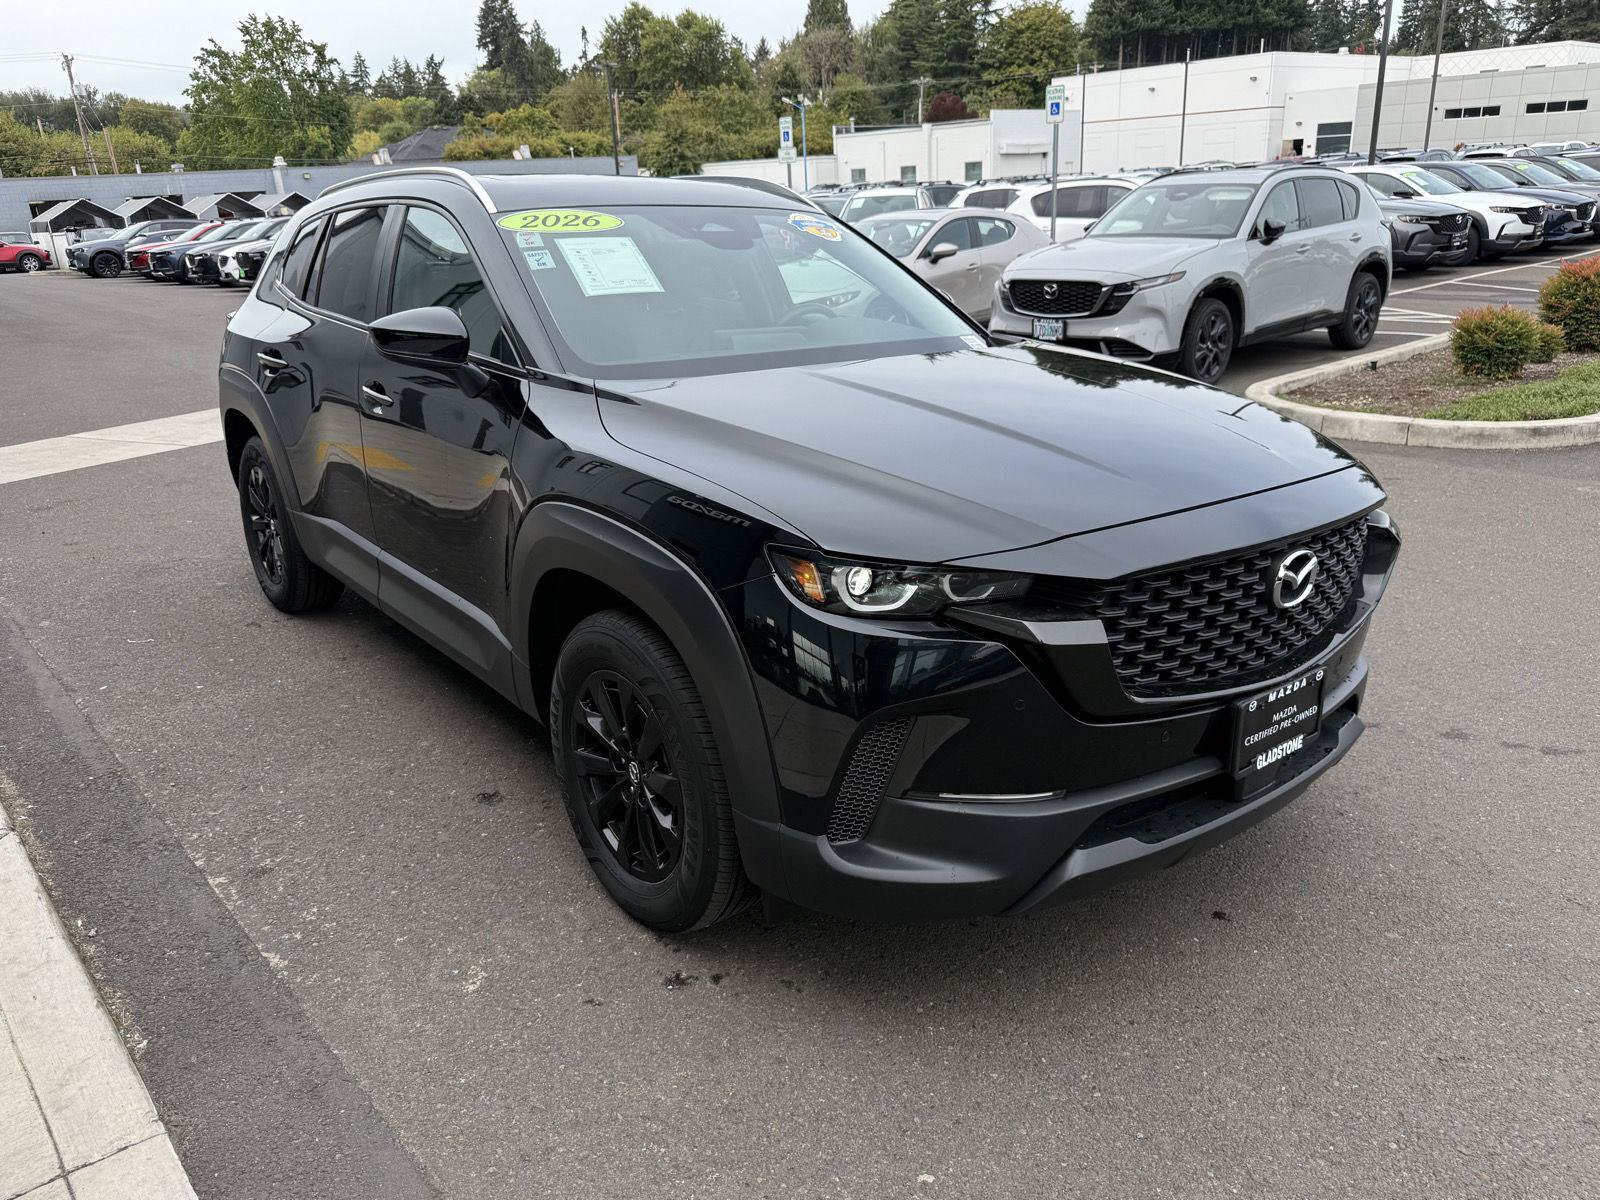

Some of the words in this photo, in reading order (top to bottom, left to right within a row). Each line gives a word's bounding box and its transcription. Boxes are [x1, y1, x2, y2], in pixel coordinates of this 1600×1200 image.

[520, 214, 602, 229] 2026
[1268, 677, 1307, 703] MAZDA
[1244, 724, 1279, 746] CERTIFIED
[1279, 705, 1318, 731] PRE-OWNED
[1272, 704, 1297, 723] MAZDA
[1256, 734, 1304, 770] GLADSTONE
